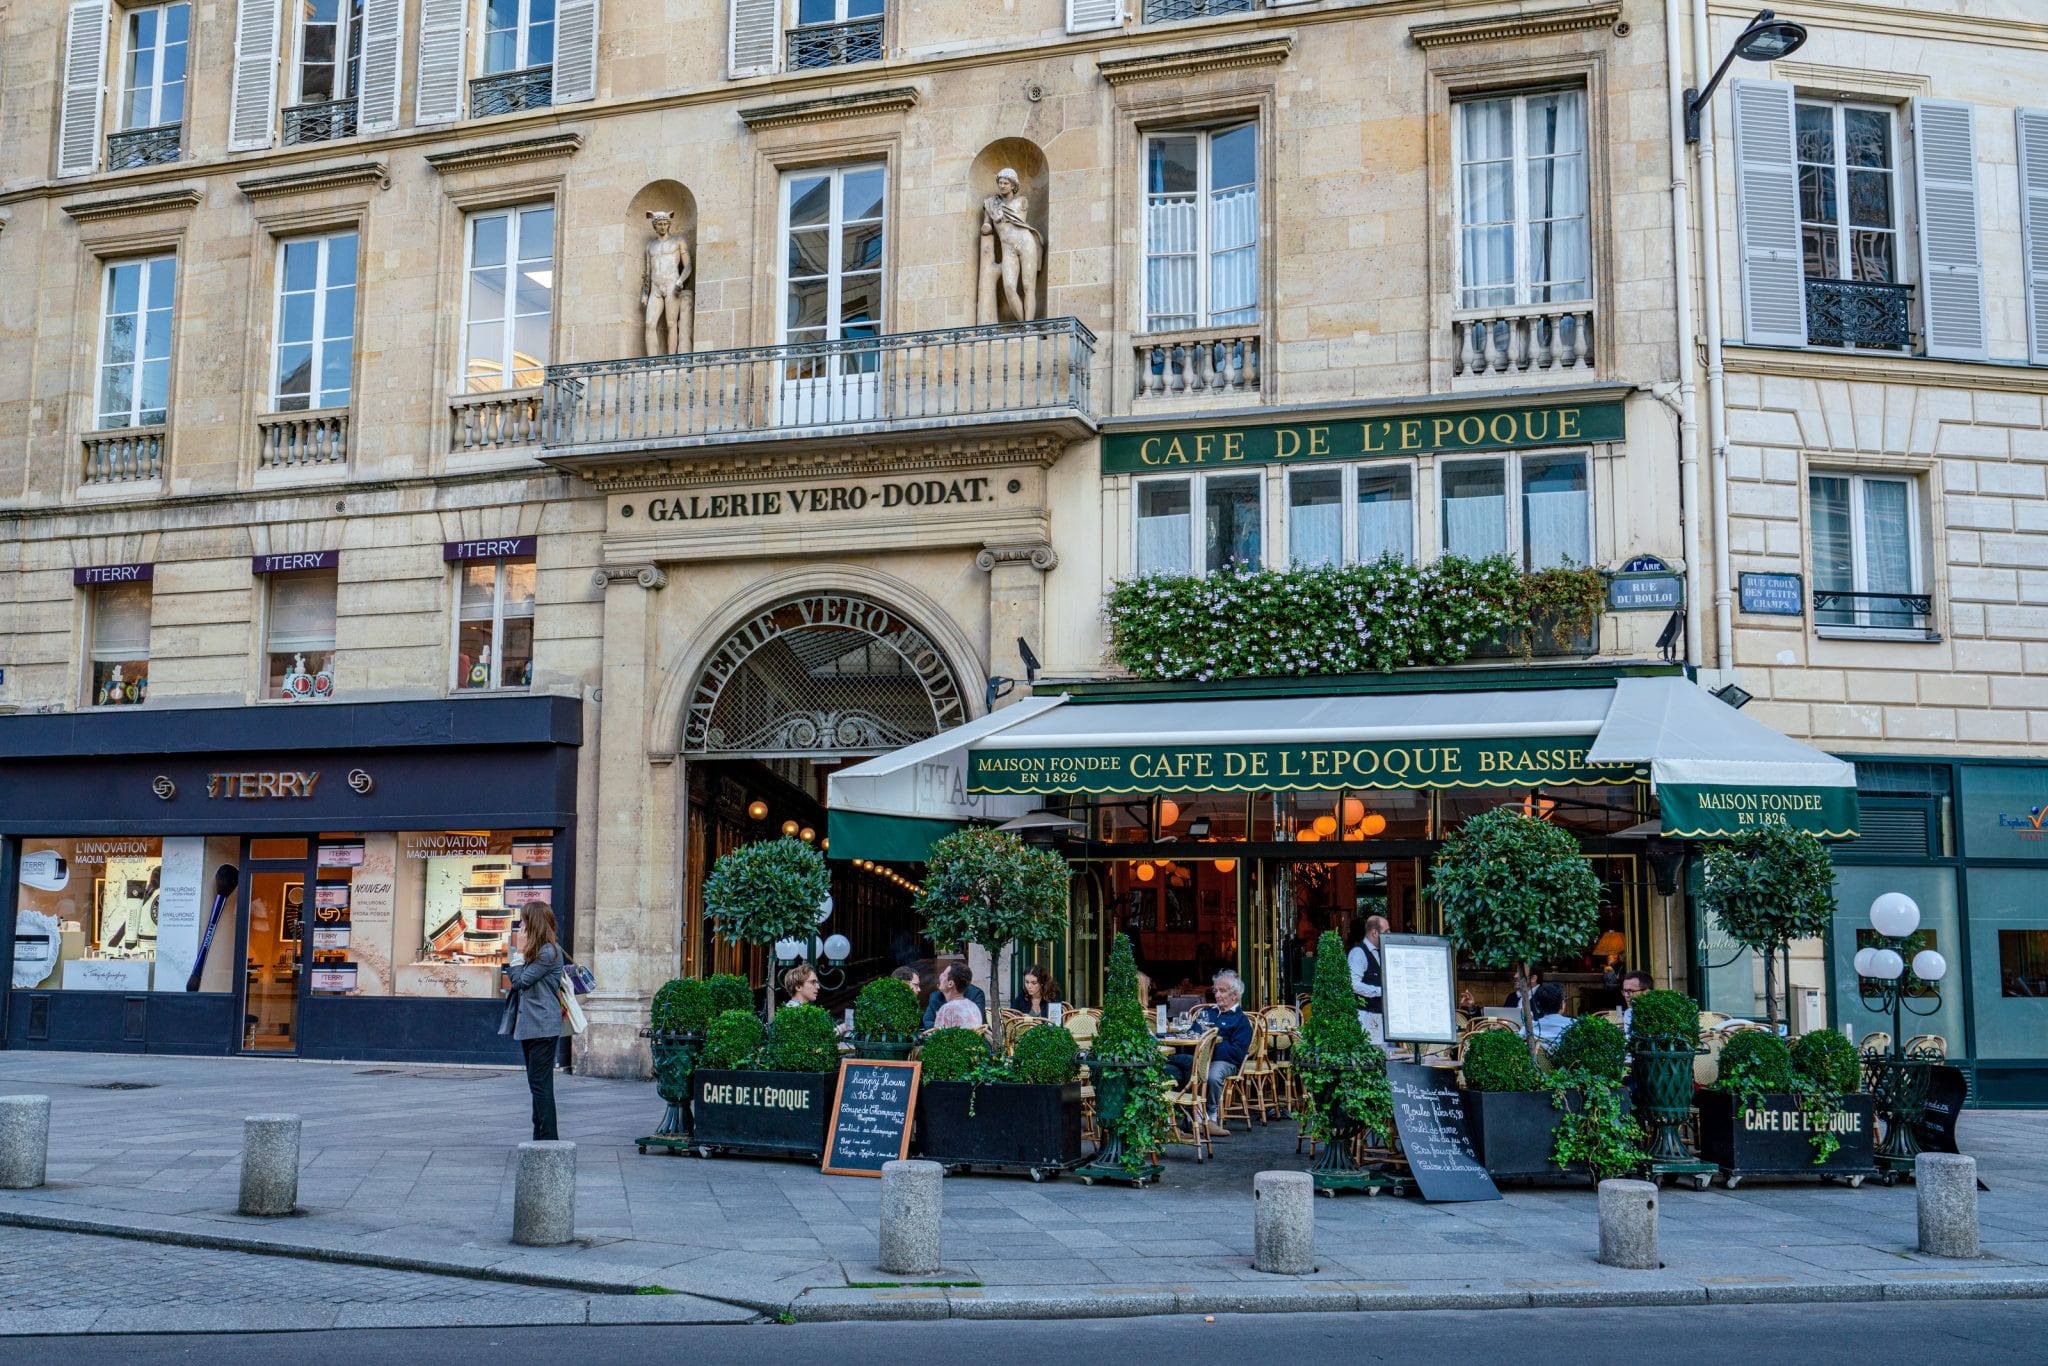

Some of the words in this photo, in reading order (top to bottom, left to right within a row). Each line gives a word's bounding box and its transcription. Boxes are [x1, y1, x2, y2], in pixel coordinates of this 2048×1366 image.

[1141, 432, 1245, 465] CAFE
[1274, 426, 1330, 458] DE
[1361, 408, 1581, 452] L'EPOQUE
[647, 491, 781, 522] GALERIE
[464, 539, 520, 557] TERRY
[271, 553, 324, 570] TERRY
[91, 566, 140, 581] TERRY
[1632, 583, 1657, 592] RUE
[1747, 578, 1765, 586] RUE
[1767, 579, 1794, 588] CROIX
[1617, 595, 1631, 604] DU
[1634, 593, 1672, 603] BOULOI
[1744, 588, 1762, 597] DES
[1765, 590, 1798, 599] PETITS
[684, 609, 782, 744] GALERIE
[797, 597, 889, 634] VERO
[894, 625, 965, 728] DODA
[978, 758, 1046, 771] MAISON
[1050, 757, 1121, 770] FONDEE
[1130, 753, 1214, 778] CAFE
[1223, 752, 1269, 777] DE
[1280, 748, 1461, 778] L'EPOQUE
[216, 771, 319, 798] TERRY
[1021, 773, 1039, 783] EN
[1045, 772, 1077, 783] 1826
[1698, 793, 1757, 810] MAISON
[1761, 794, 1822, 810] FONDEE
[1738, 812, 1754, 824] EN
[1759, 812, 1786, 825] 1826
[75, 842, 147, 853] L'INNOVATION
[407, 836, 488, 847] L'INNOVATION
[75, 855, 125, 864] MAQUILLAGE
[127, 855, 147, 864] SOIN
[406, 850, 464, 859] MAQUILLAGE
[465, 850, 488, 858] SOIN
[355, 884, 391, 894] NOUVEAU
[851, 1071, 880, 1091] happy
[703, 1082, 733, 1104] CAFÉ
[735, 1086, 751, 1105] DE
[753, 1085, 810, 1111] L'ÉPOQUE
[1401, 1103, 1431, 1120] Moules
[1745, 1108, 1779, 1131] CAFÉ
[1782, 1111, 1799, 1131] DE
